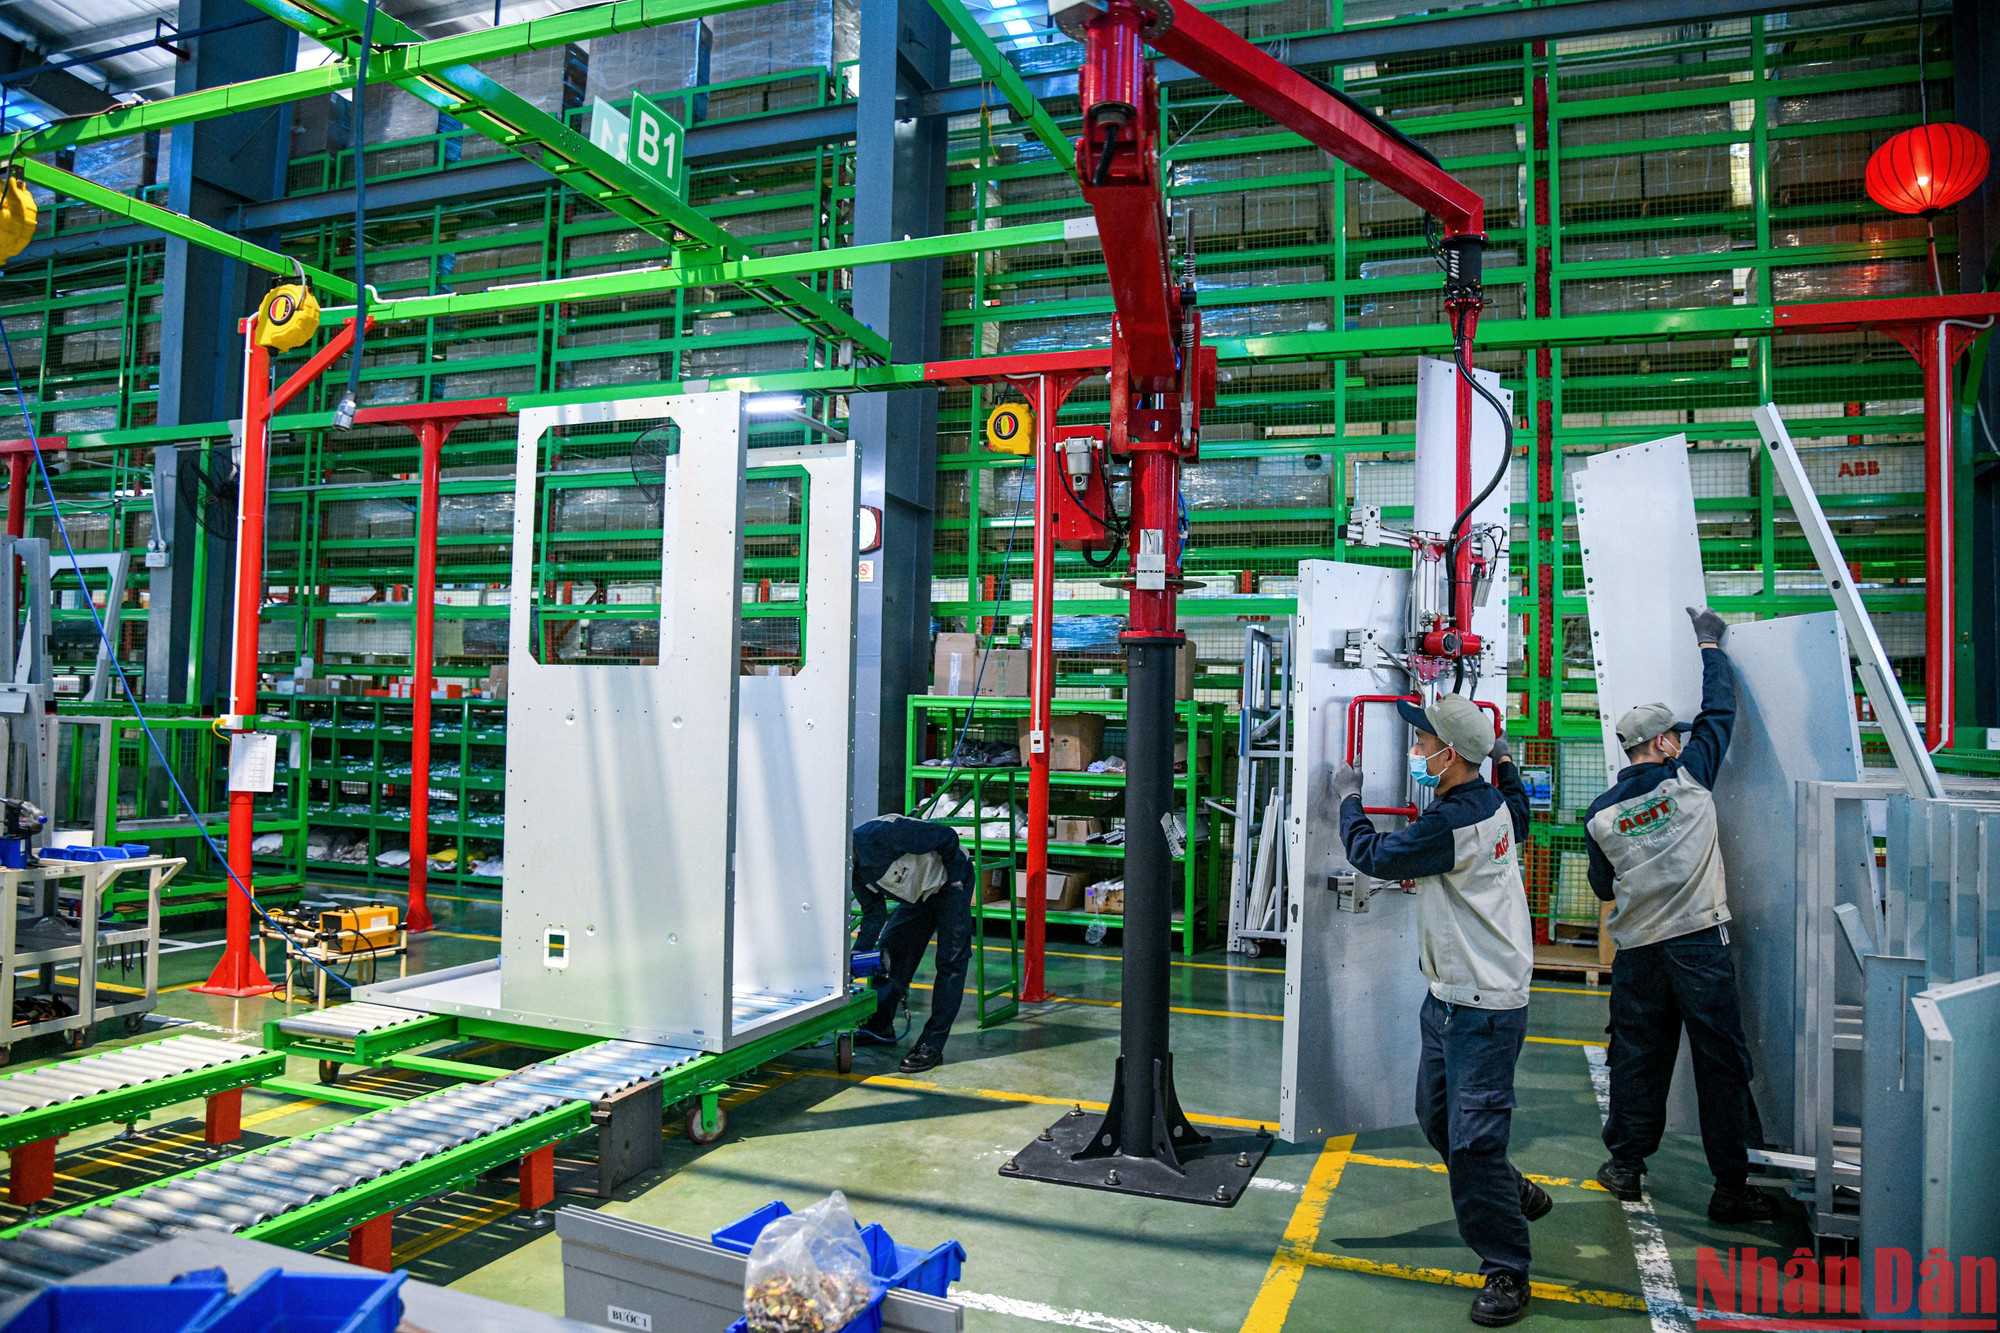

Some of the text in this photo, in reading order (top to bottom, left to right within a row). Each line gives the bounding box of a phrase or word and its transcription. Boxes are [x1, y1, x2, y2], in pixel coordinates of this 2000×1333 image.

[638, 110, 676, 179] B1
[1837, 461, 1880, 478] ABB
[1620, 799, 1670, 832] ACIT
